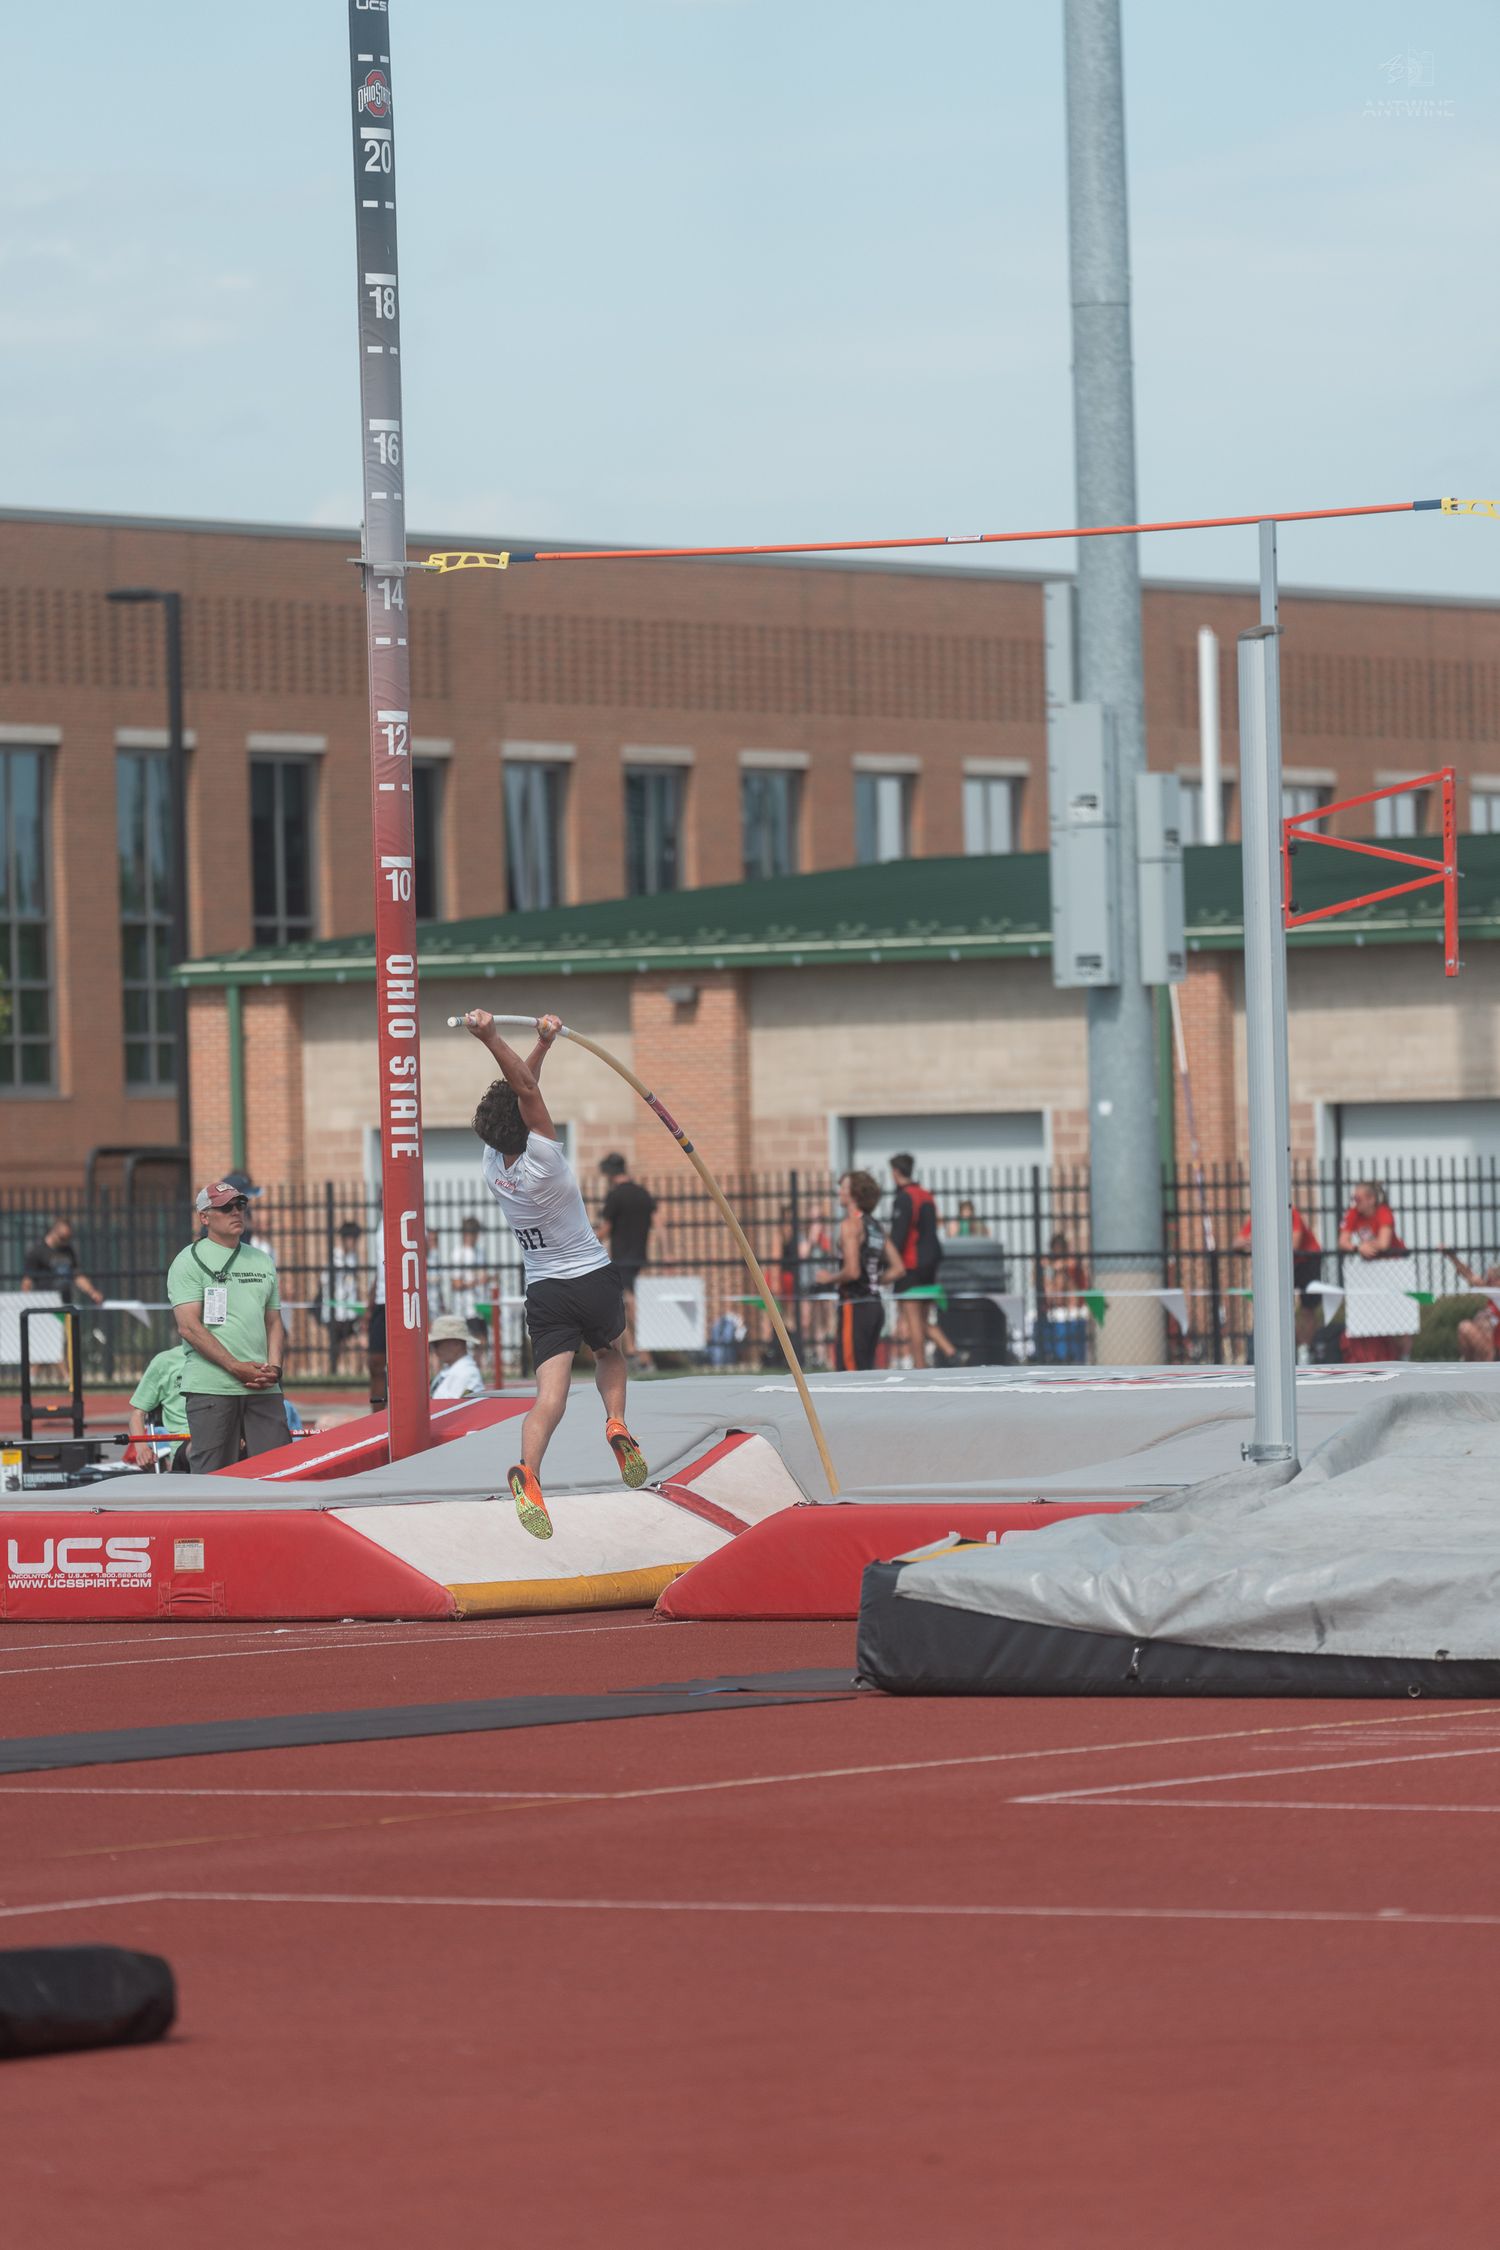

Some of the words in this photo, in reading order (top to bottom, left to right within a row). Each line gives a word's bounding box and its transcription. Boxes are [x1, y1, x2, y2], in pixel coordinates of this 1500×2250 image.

[356, 0, 387, 12] UCS
[364, 140, 392, 174] 20
[369, 286, 396, 320] 18
[373, 432, 400, 465] 16
[377, 578, 404, 611] 14
[381, 723, 408, 756] 12
[385, 869, 412, 902] 10
[386, 954, 416, 1039] OHIO
[389, 1055, 419, 1159] STATE
[400, 1210, 421, 1330] UCS
[8, 1537, 151, 1573] UCS
[8, 1578, 152, 1589] WWW.UCSSPIRIT.COM
